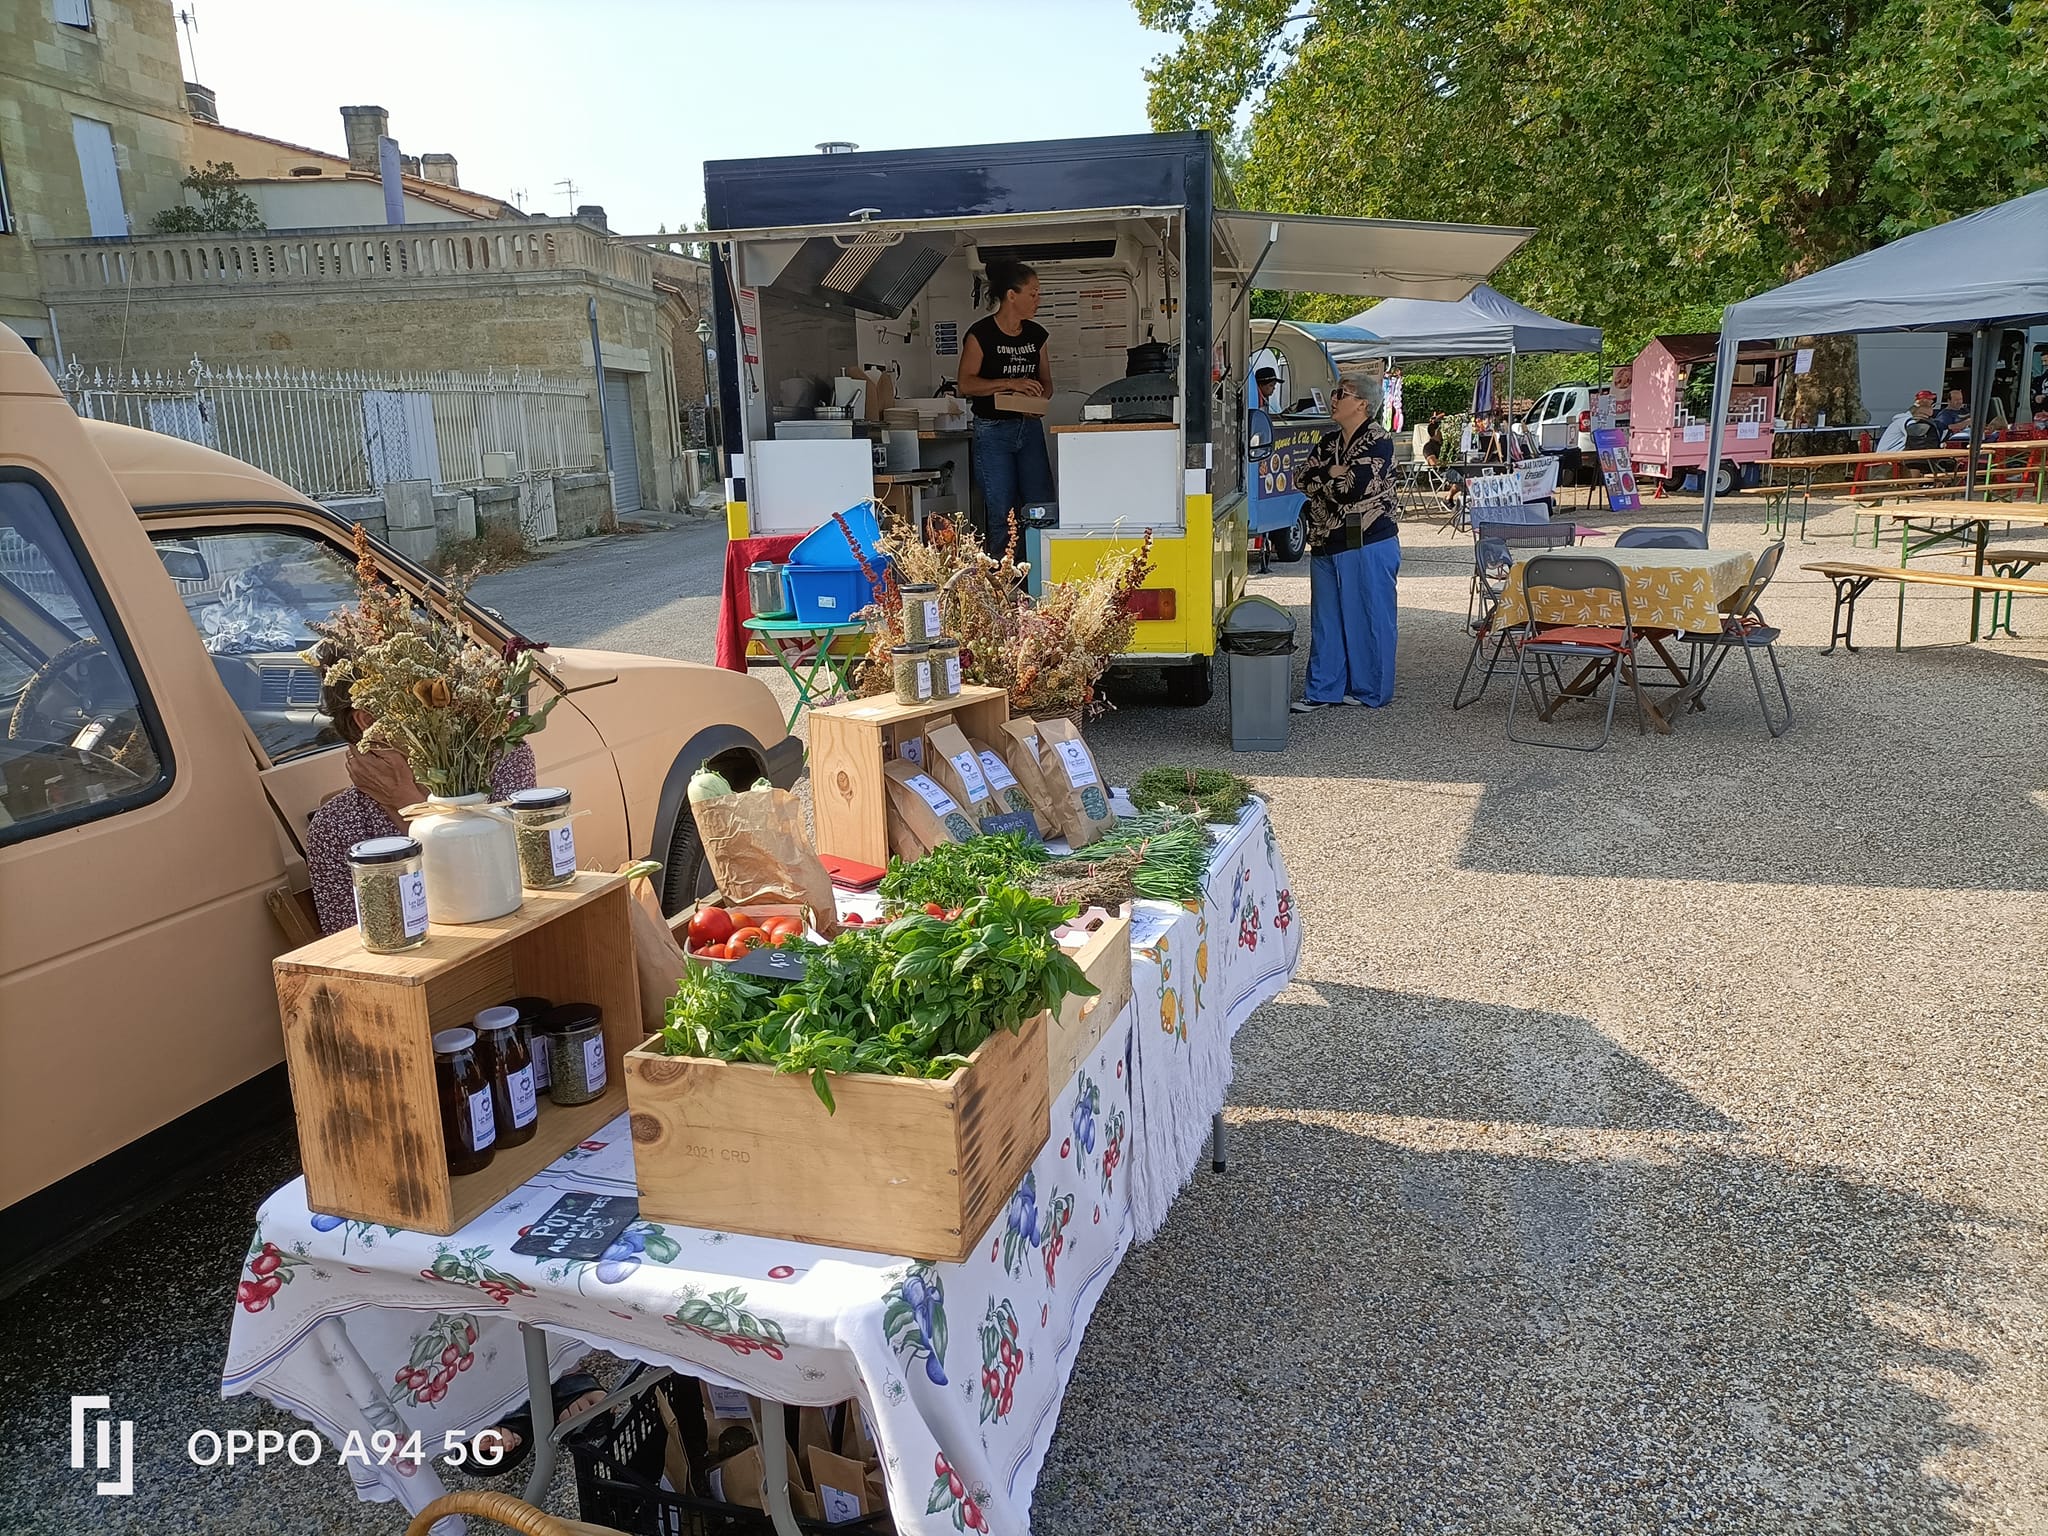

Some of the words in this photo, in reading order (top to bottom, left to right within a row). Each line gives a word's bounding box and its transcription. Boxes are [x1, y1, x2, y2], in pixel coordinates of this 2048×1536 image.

[1002, 364, 1036, 374] PARFAITE
[686, 1144, 714, 1159] 2021
[720, 1148, 751, 1163] CRD
[530, 1208, 577, 1237] POT
[547, 1195, 613, 1253] AROMATES
